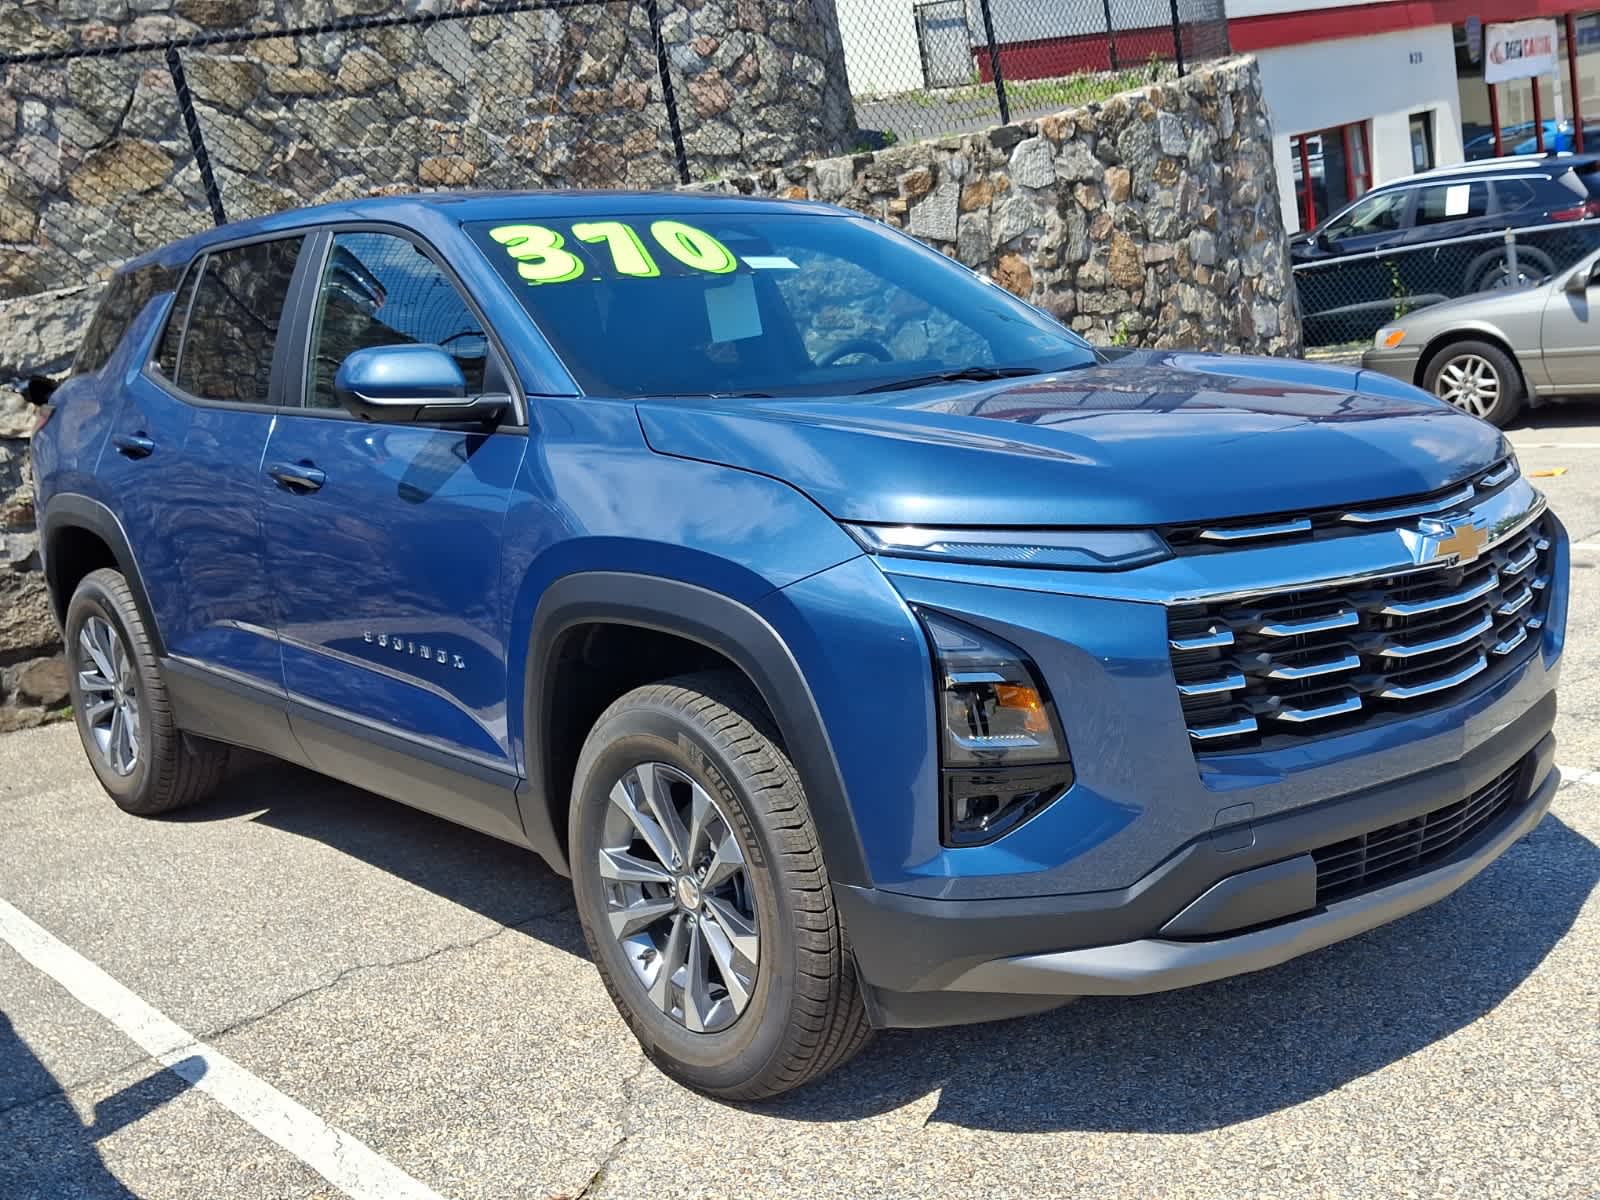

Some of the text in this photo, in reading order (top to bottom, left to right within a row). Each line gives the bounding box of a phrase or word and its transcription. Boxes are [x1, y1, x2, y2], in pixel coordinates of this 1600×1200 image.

[489, 220, 737, 285] 370
[363, 631, 465, 669] EQUINOX
[703, 765, 766, 868] MICHELIN
